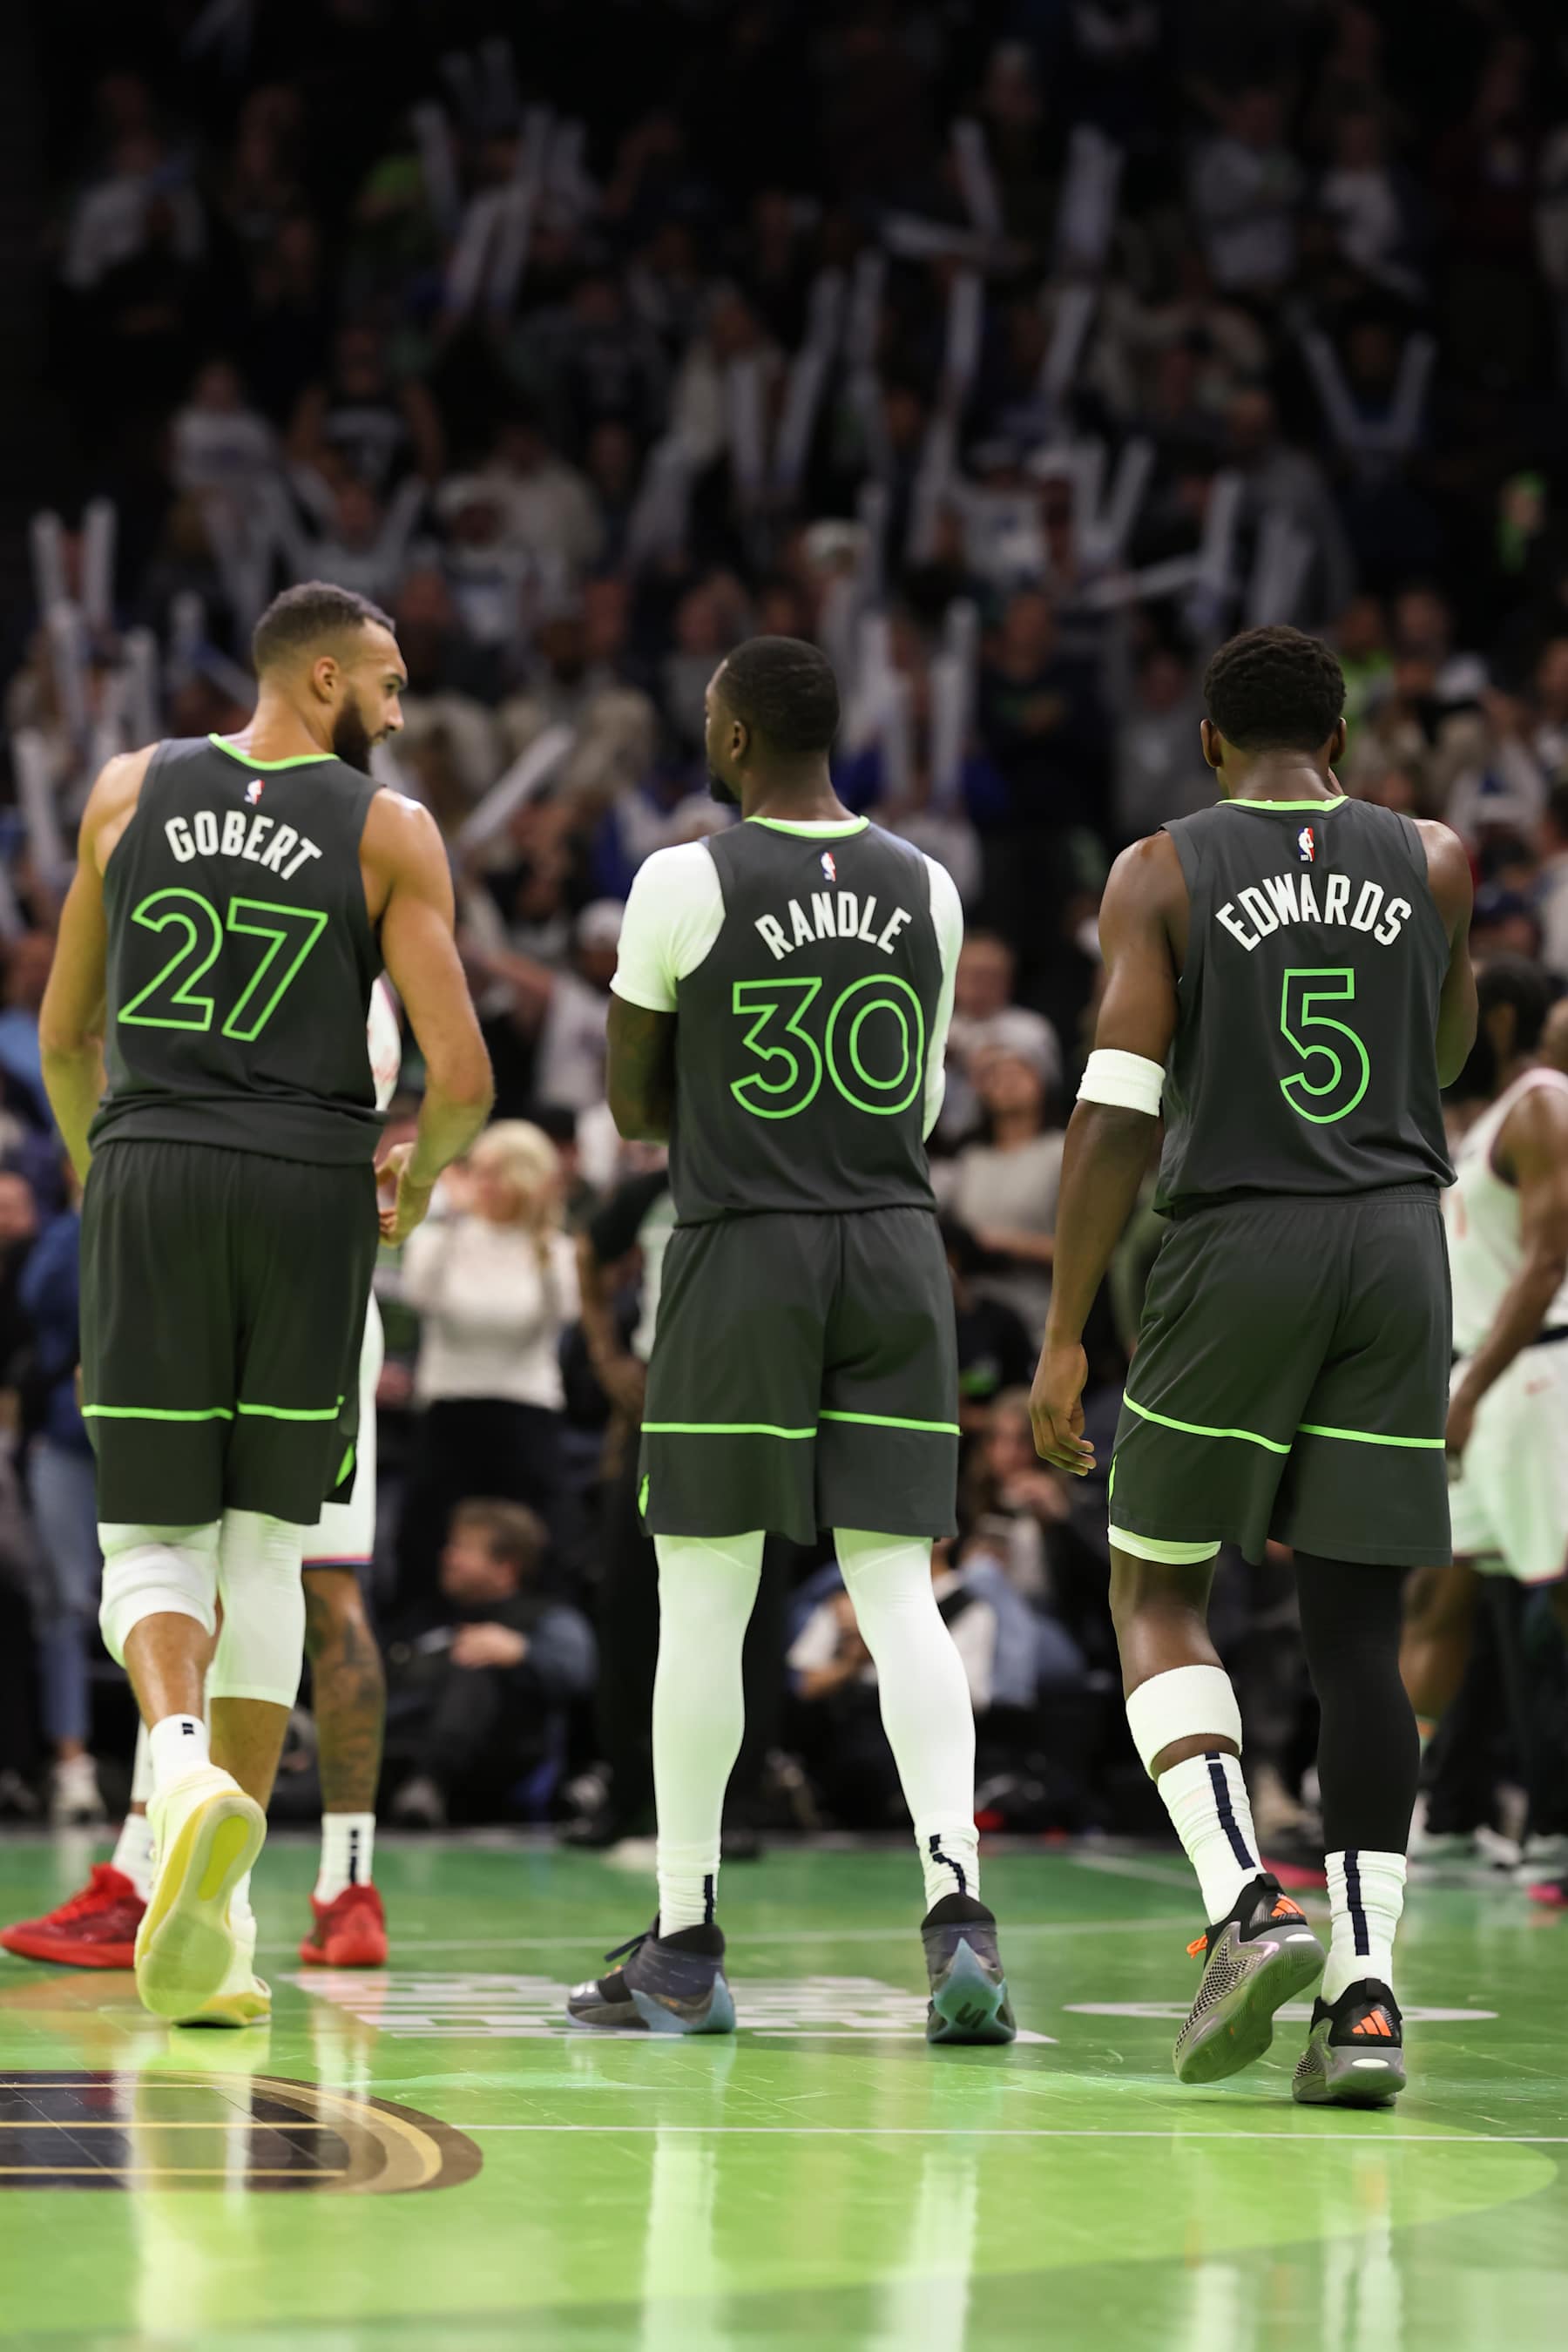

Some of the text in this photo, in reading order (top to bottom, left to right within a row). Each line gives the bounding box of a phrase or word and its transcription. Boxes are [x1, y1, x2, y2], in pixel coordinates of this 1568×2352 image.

[164, 810, 323, 881] GOBERT
[118, 888, 328, 1041] 27
[754, 890, 912, 960] RANDLE
[1215, 872, 1412, 951] EDWARDS
[730, 974, 924, 1119] 30
[1280, 968, 1370, 1124] 5
